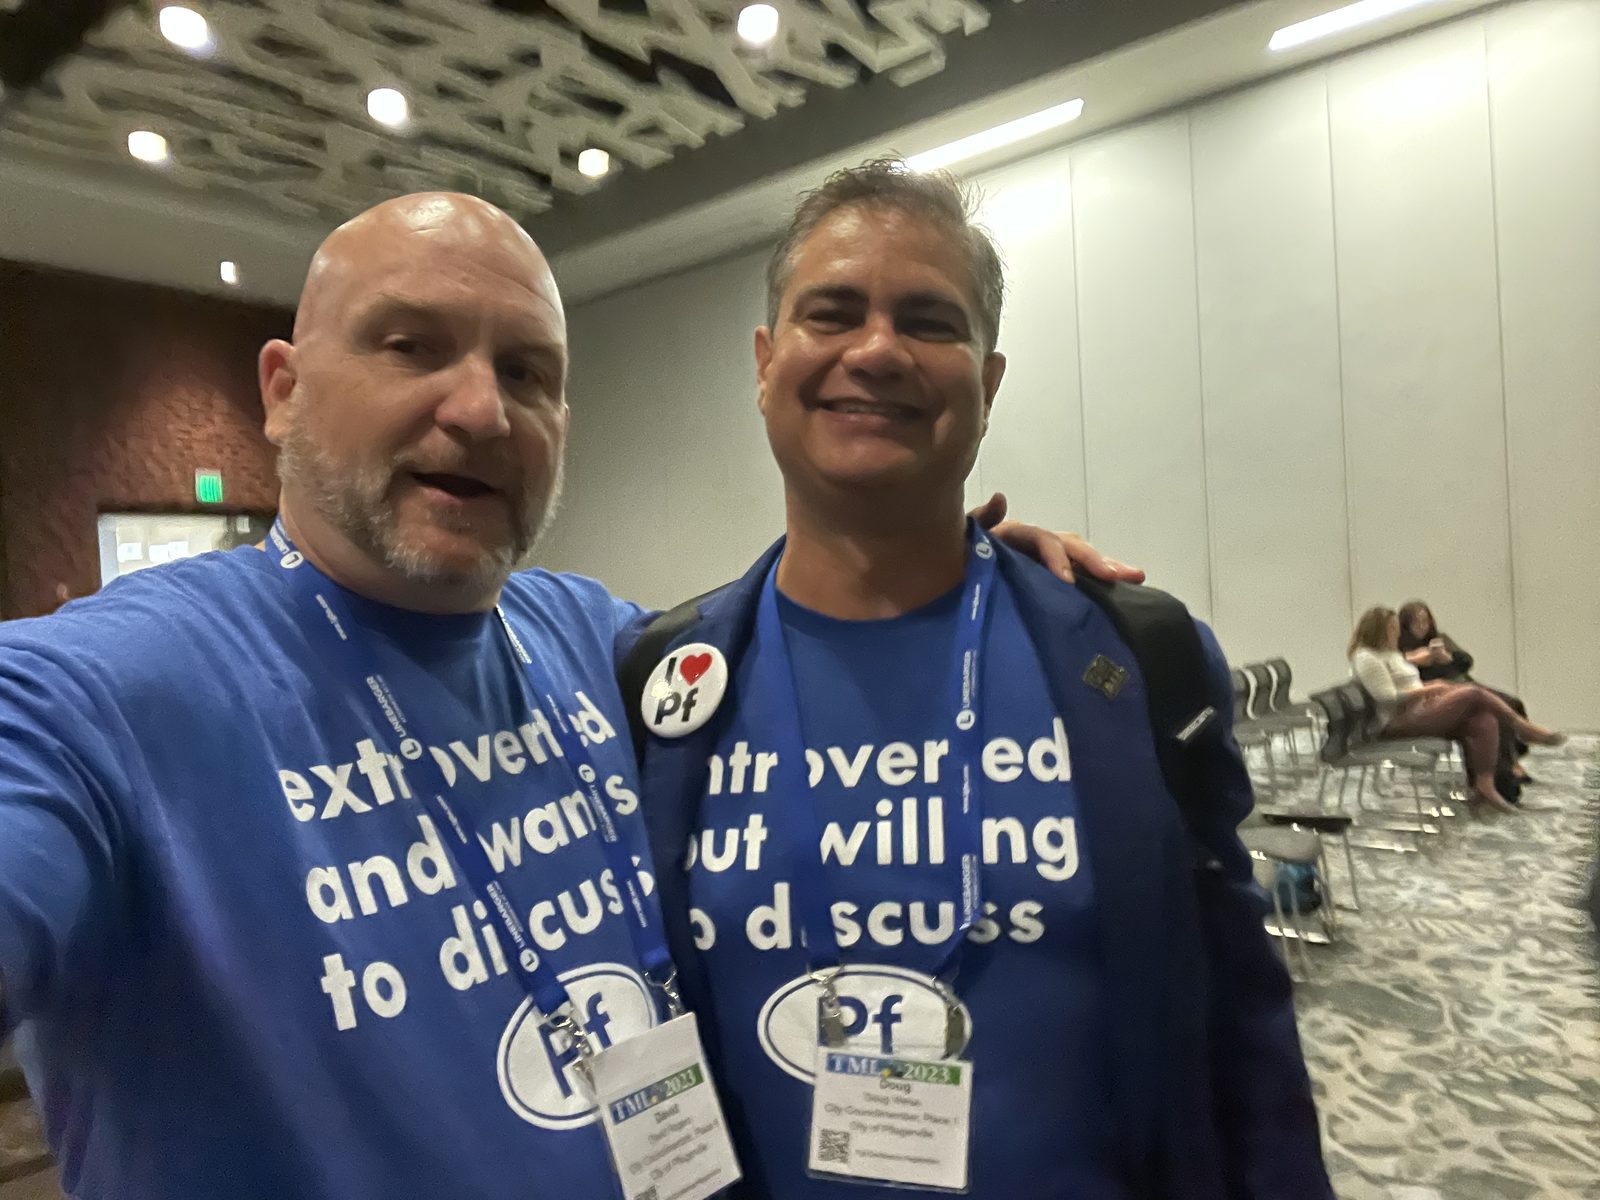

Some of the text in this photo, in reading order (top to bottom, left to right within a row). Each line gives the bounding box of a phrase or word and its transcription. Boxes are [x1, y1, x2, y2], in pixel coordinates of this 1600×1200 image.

[366, 676, 407, 738] LINEBARGER
[306, 814, 456, 923] and
[476, 775, 638, 873] wans
[684, 813, 768, 872] ut
[820, 796, 1079, 881] willng
[487, 882, 526, 949] LINEBARGER
[746, 882, 1044, 950] dscuss
[320, 953, 407, 1031] to
[664, 1068, 697, 1097] 2023
[903, 1063, 951, 1082] 2023
